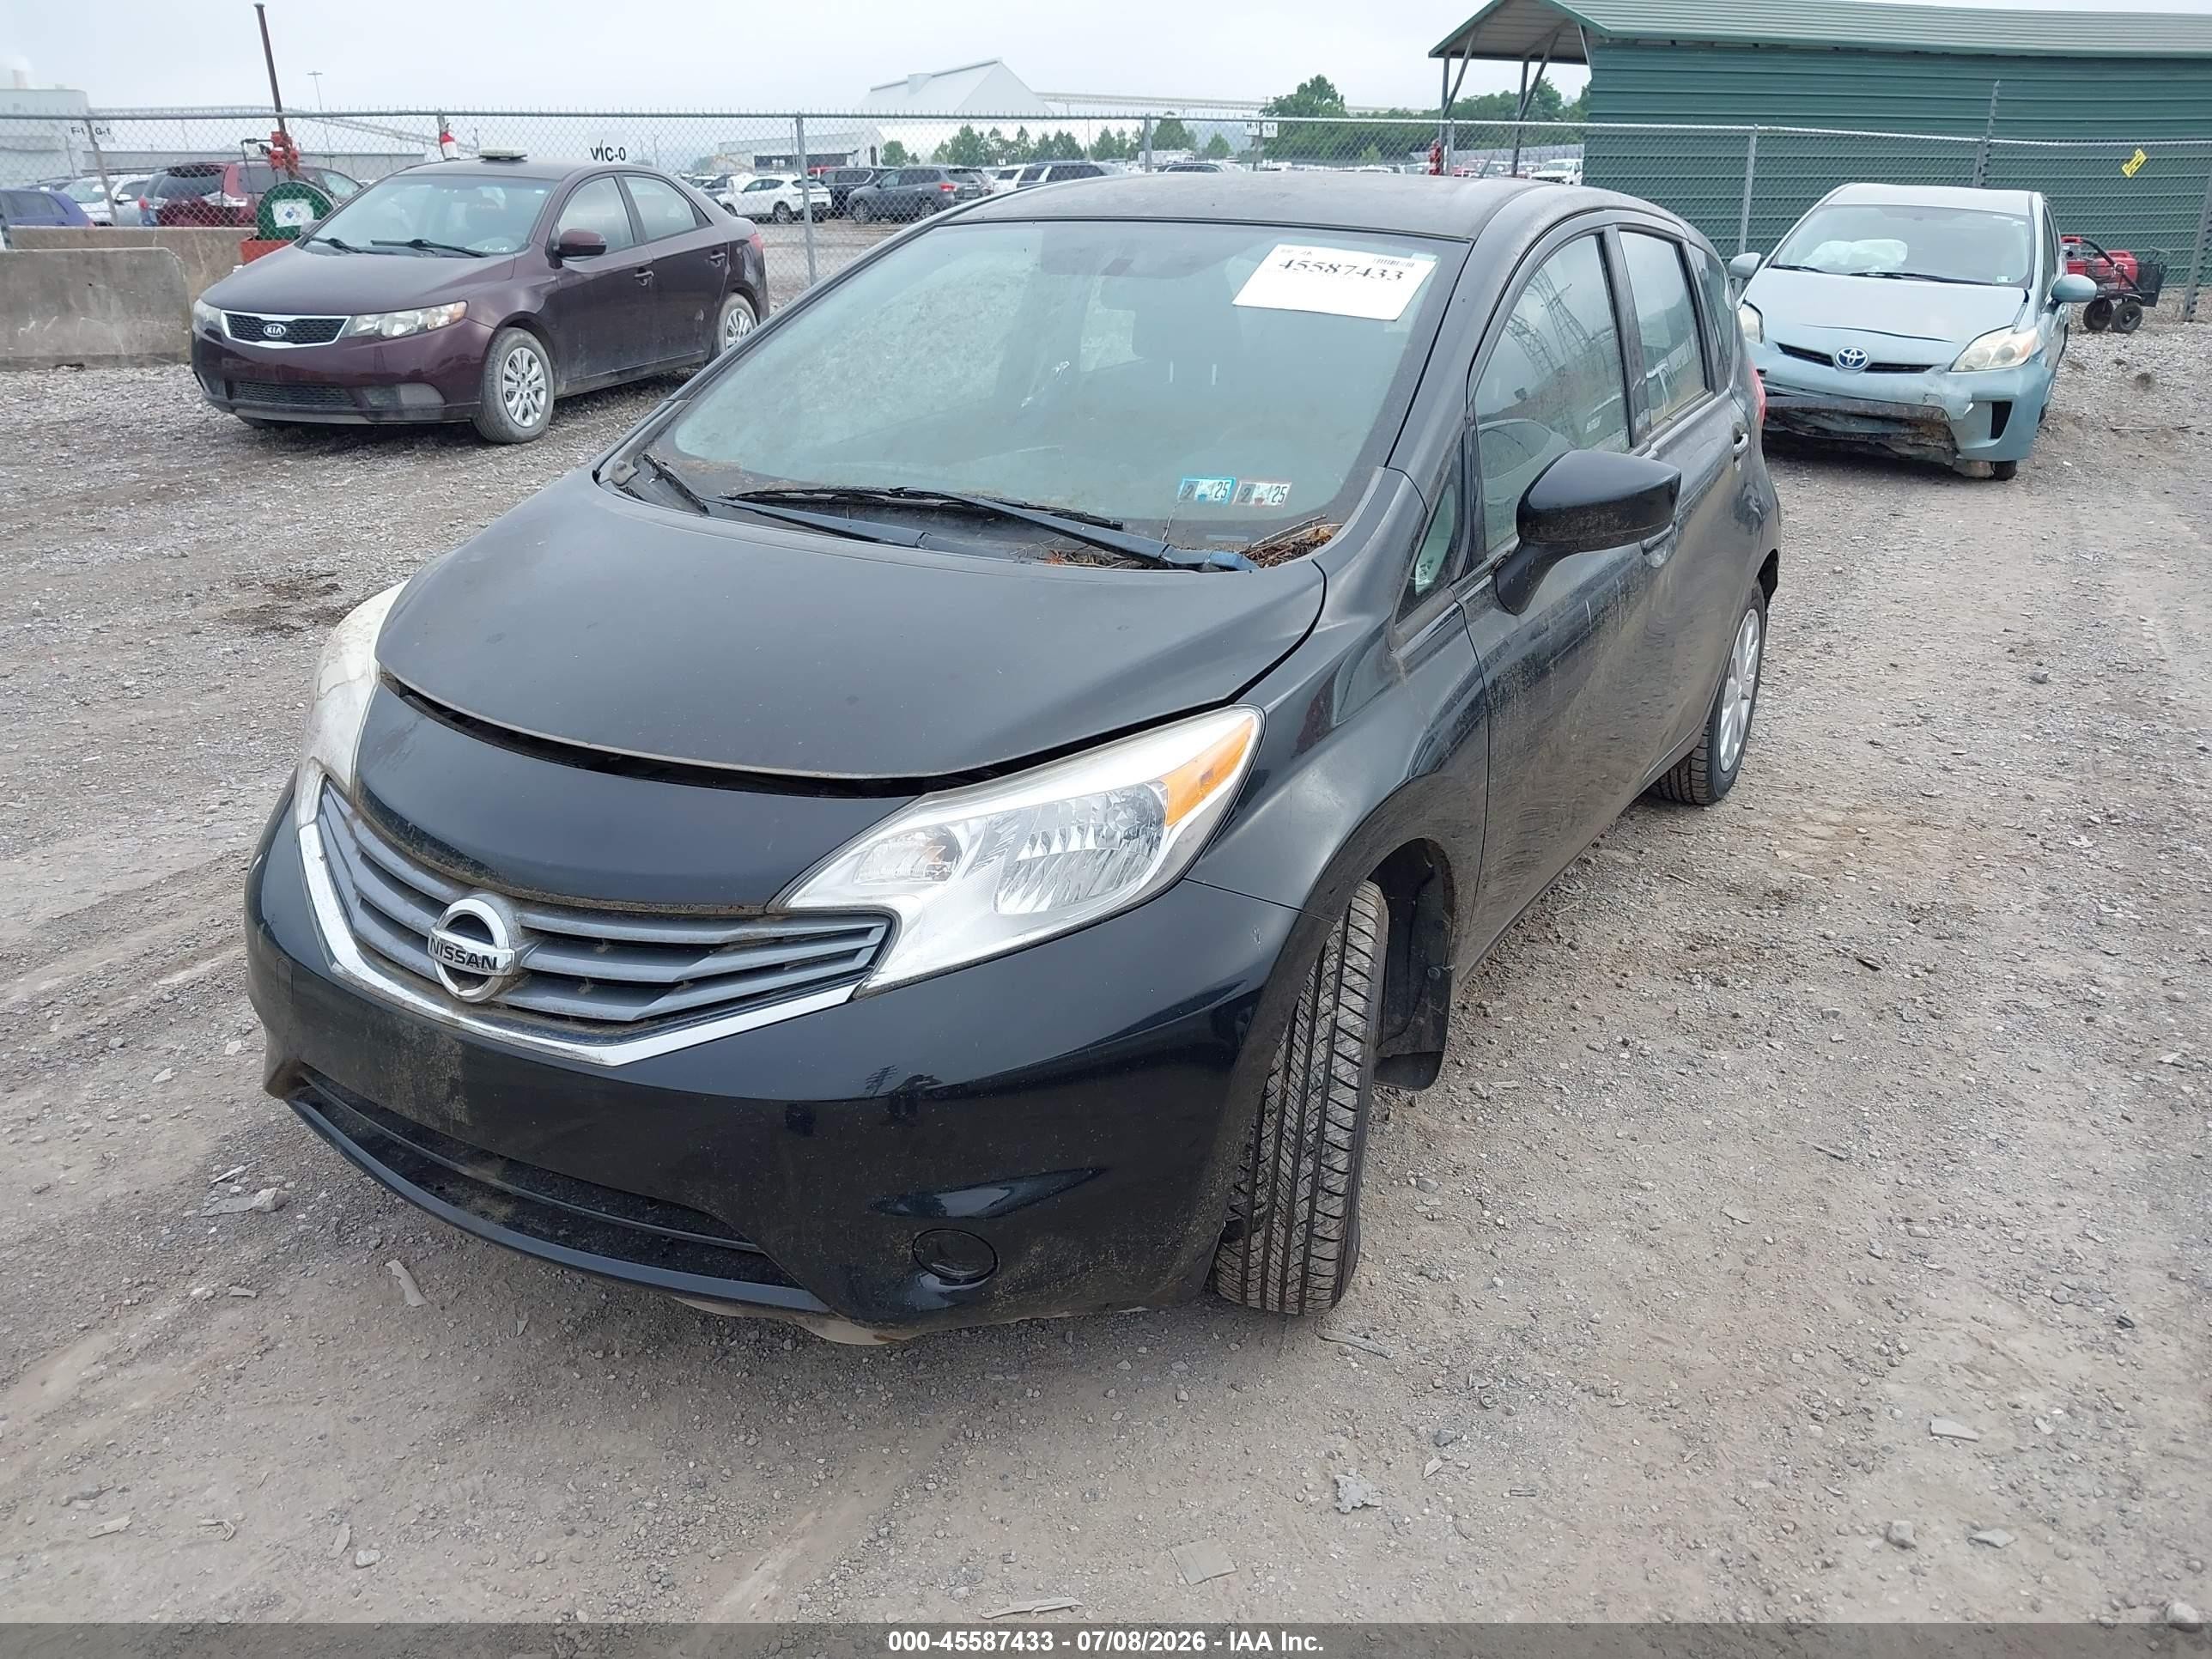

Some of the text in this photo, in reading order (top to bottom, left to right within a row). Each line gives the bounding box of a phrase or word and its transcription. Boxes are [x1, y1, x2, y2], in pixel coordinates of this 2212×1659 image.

[70, 126, 85, 137] F-1
[95, 126, 111, 136] G-1
[1278, 258, 1405, 282] 45587433
[266, 325, 283, 336] KIA
[1213, 481, 1231, 499] 25
[1270, 485, 1288, 504] 25
[430, 934, 498, 971] NISSAN
